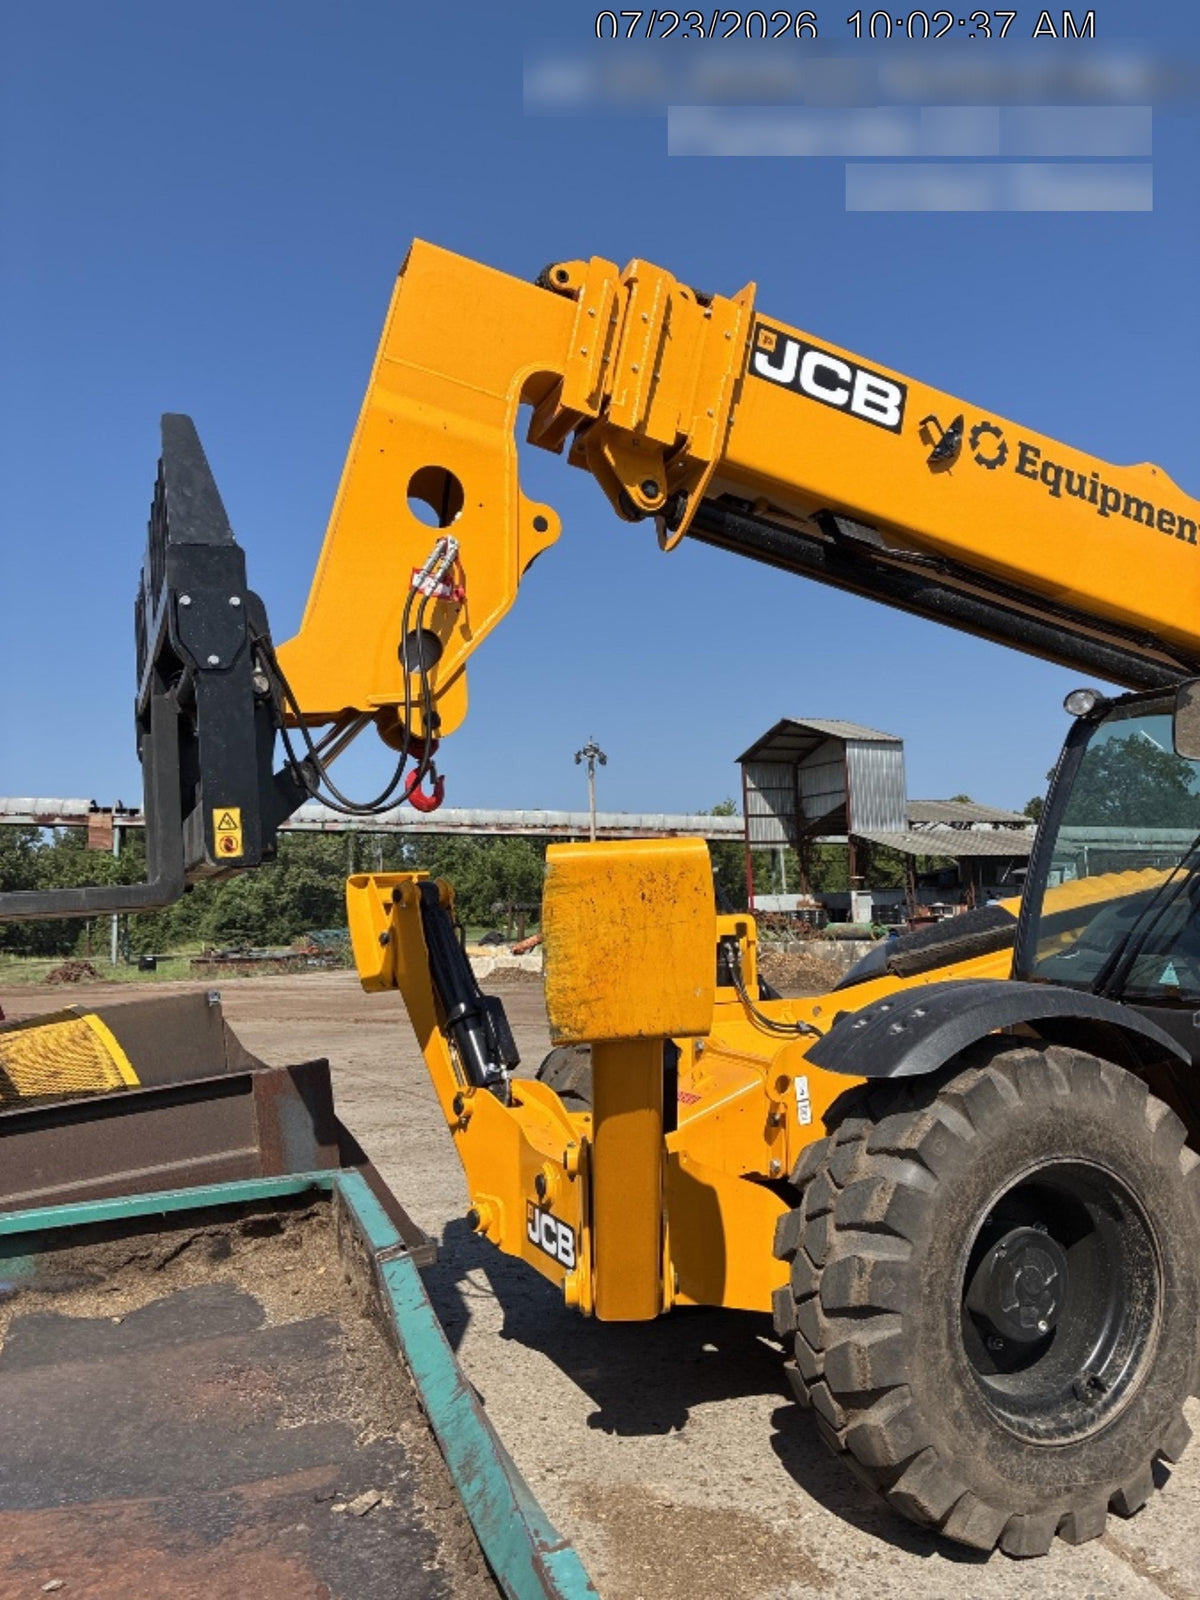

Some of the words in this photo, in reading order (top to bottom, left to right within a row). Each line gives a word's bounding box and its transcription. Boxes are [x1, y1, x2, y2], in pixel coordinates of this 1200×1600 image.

[754, 338, 902, 427] JCB
[1014, 439, 1200, 547] Equipmen
[527, 1207, 576, 1269] JCB
